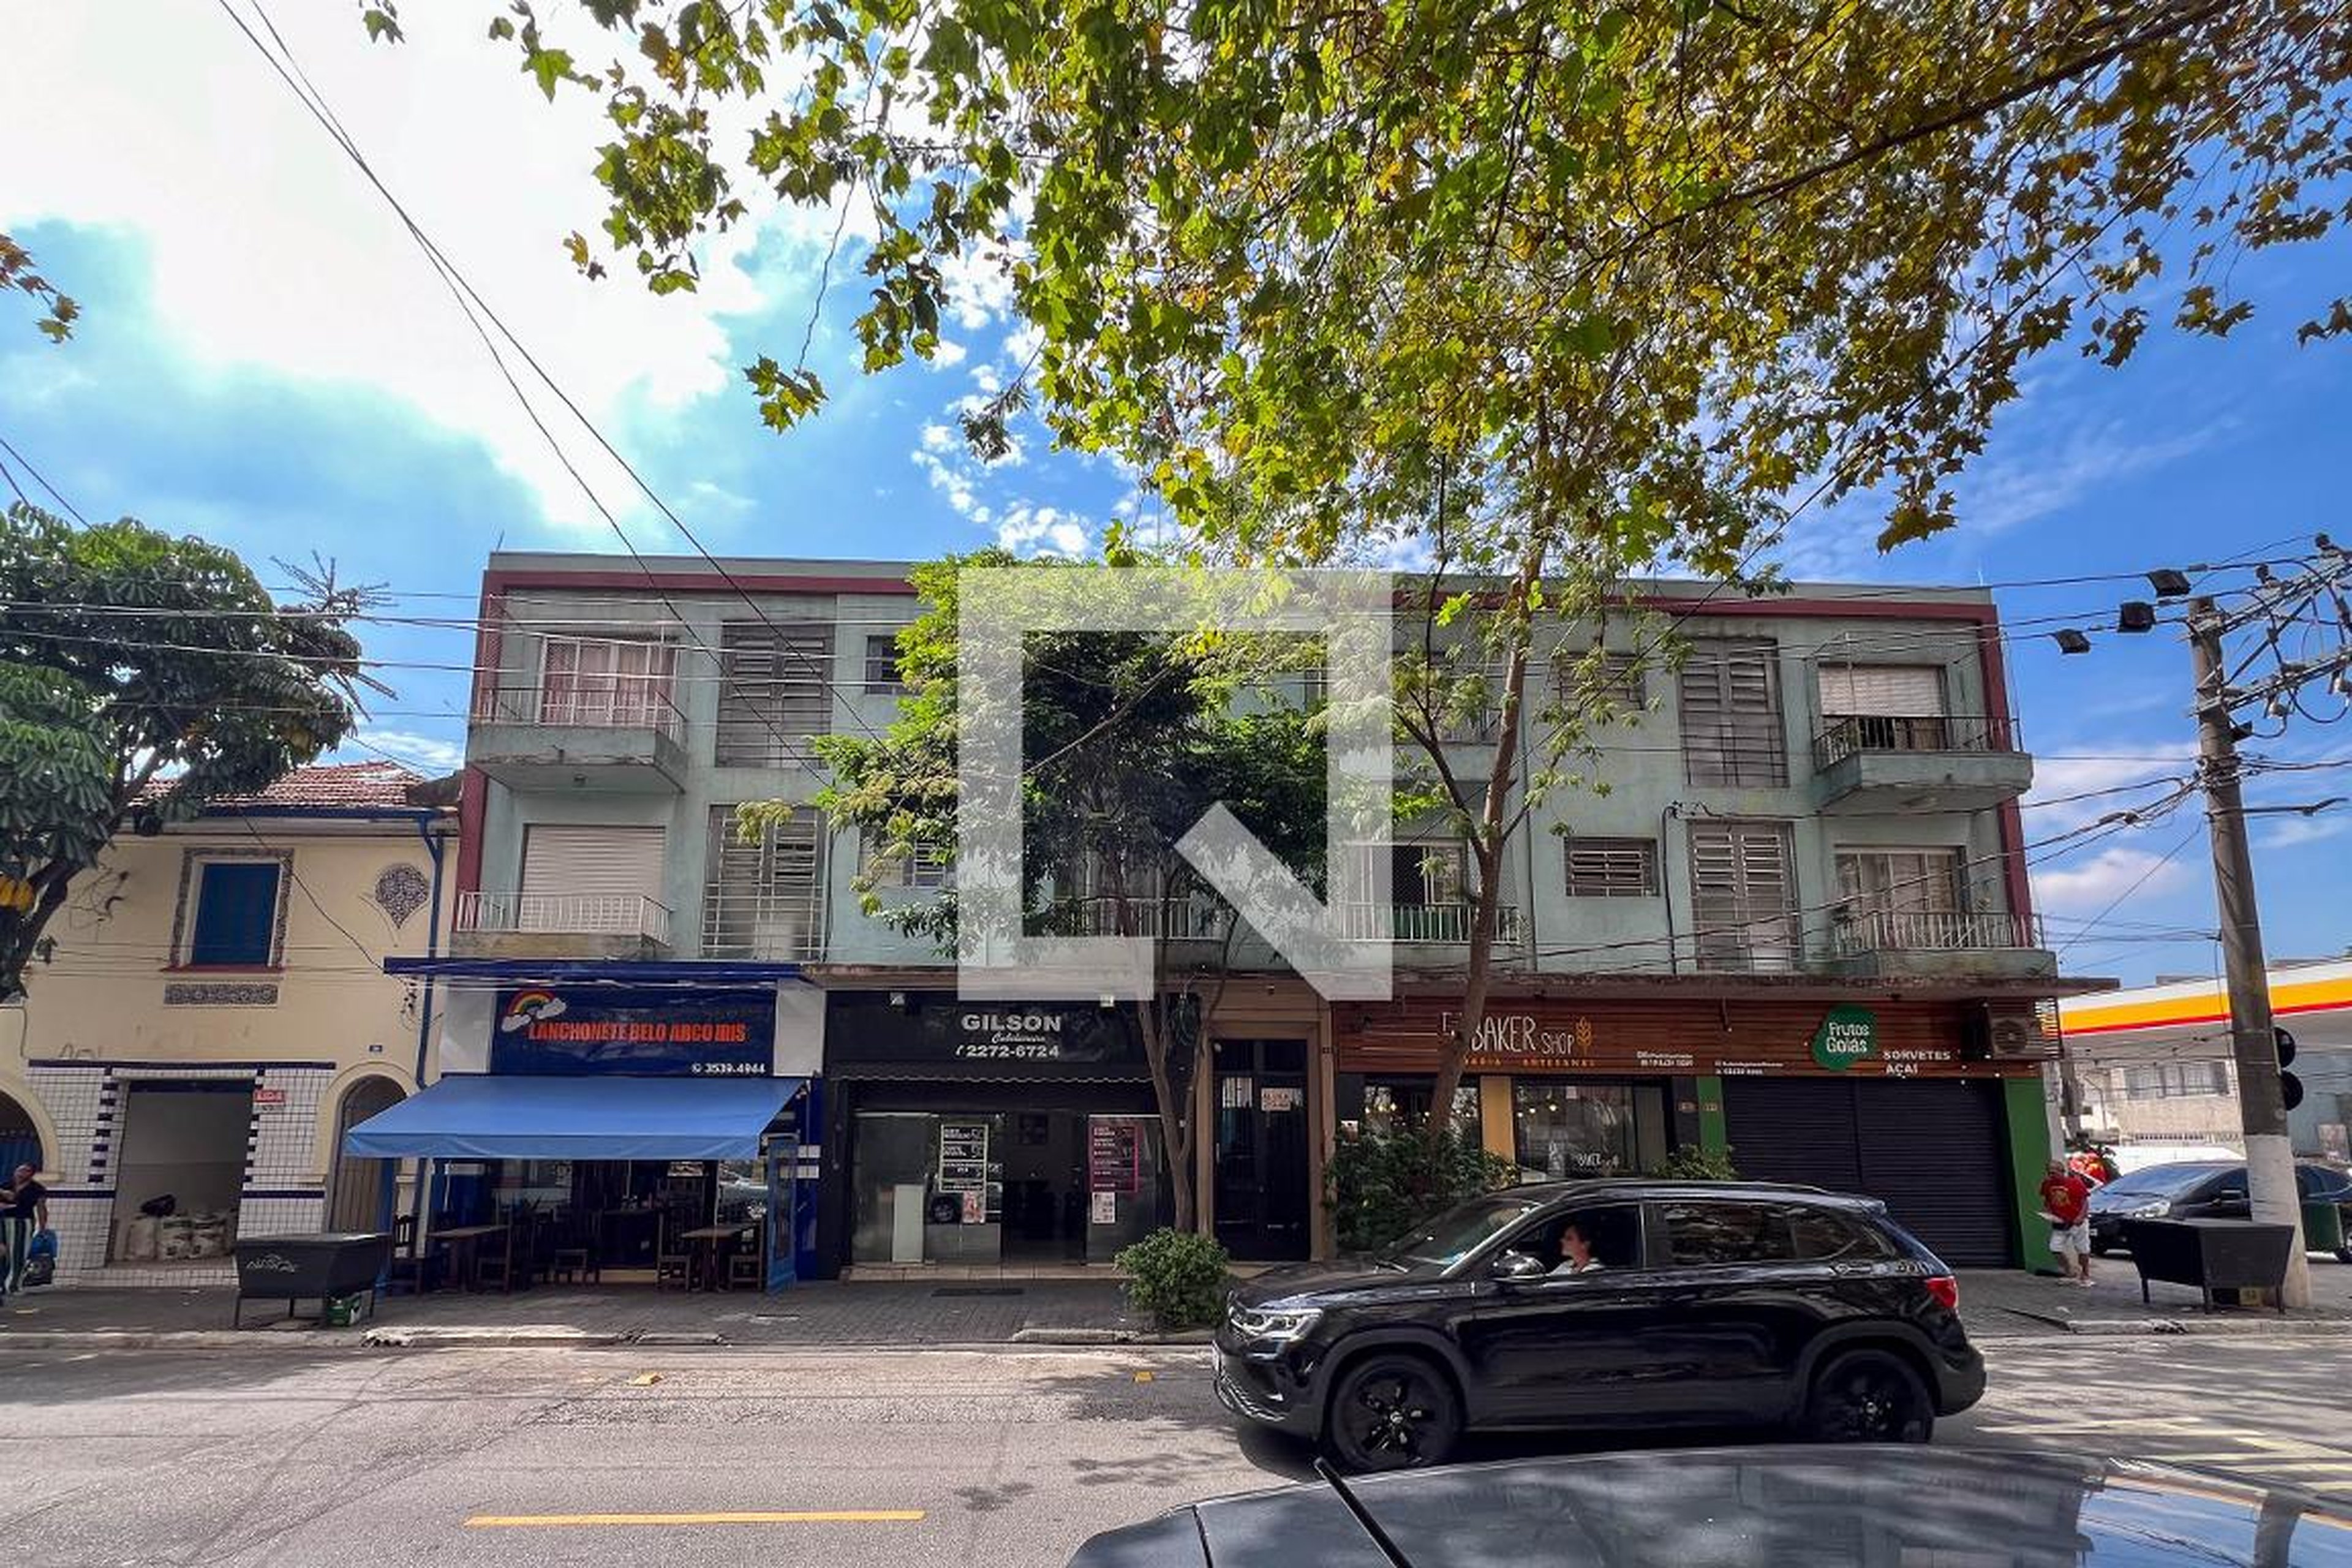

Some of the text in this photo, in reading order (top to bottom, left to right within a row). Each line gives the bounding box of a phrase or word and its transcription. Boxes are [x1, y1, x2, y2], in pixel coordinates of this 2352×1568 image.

[960, 1014, 1062, 1032] GILSON
[1828, 1022, 1869, 1036] Frutos
[528, 1022, 747, 1042] LANCHONETE BELO ARCO IRIS
[965, 1044, 1060, 1058] 2272-6724
[1541, 1032, 1575, 1055] SHOP
[1826, 1036, 1868, 1053] Goiás
[1882, 1050, 1951, 1060] SORVETES
